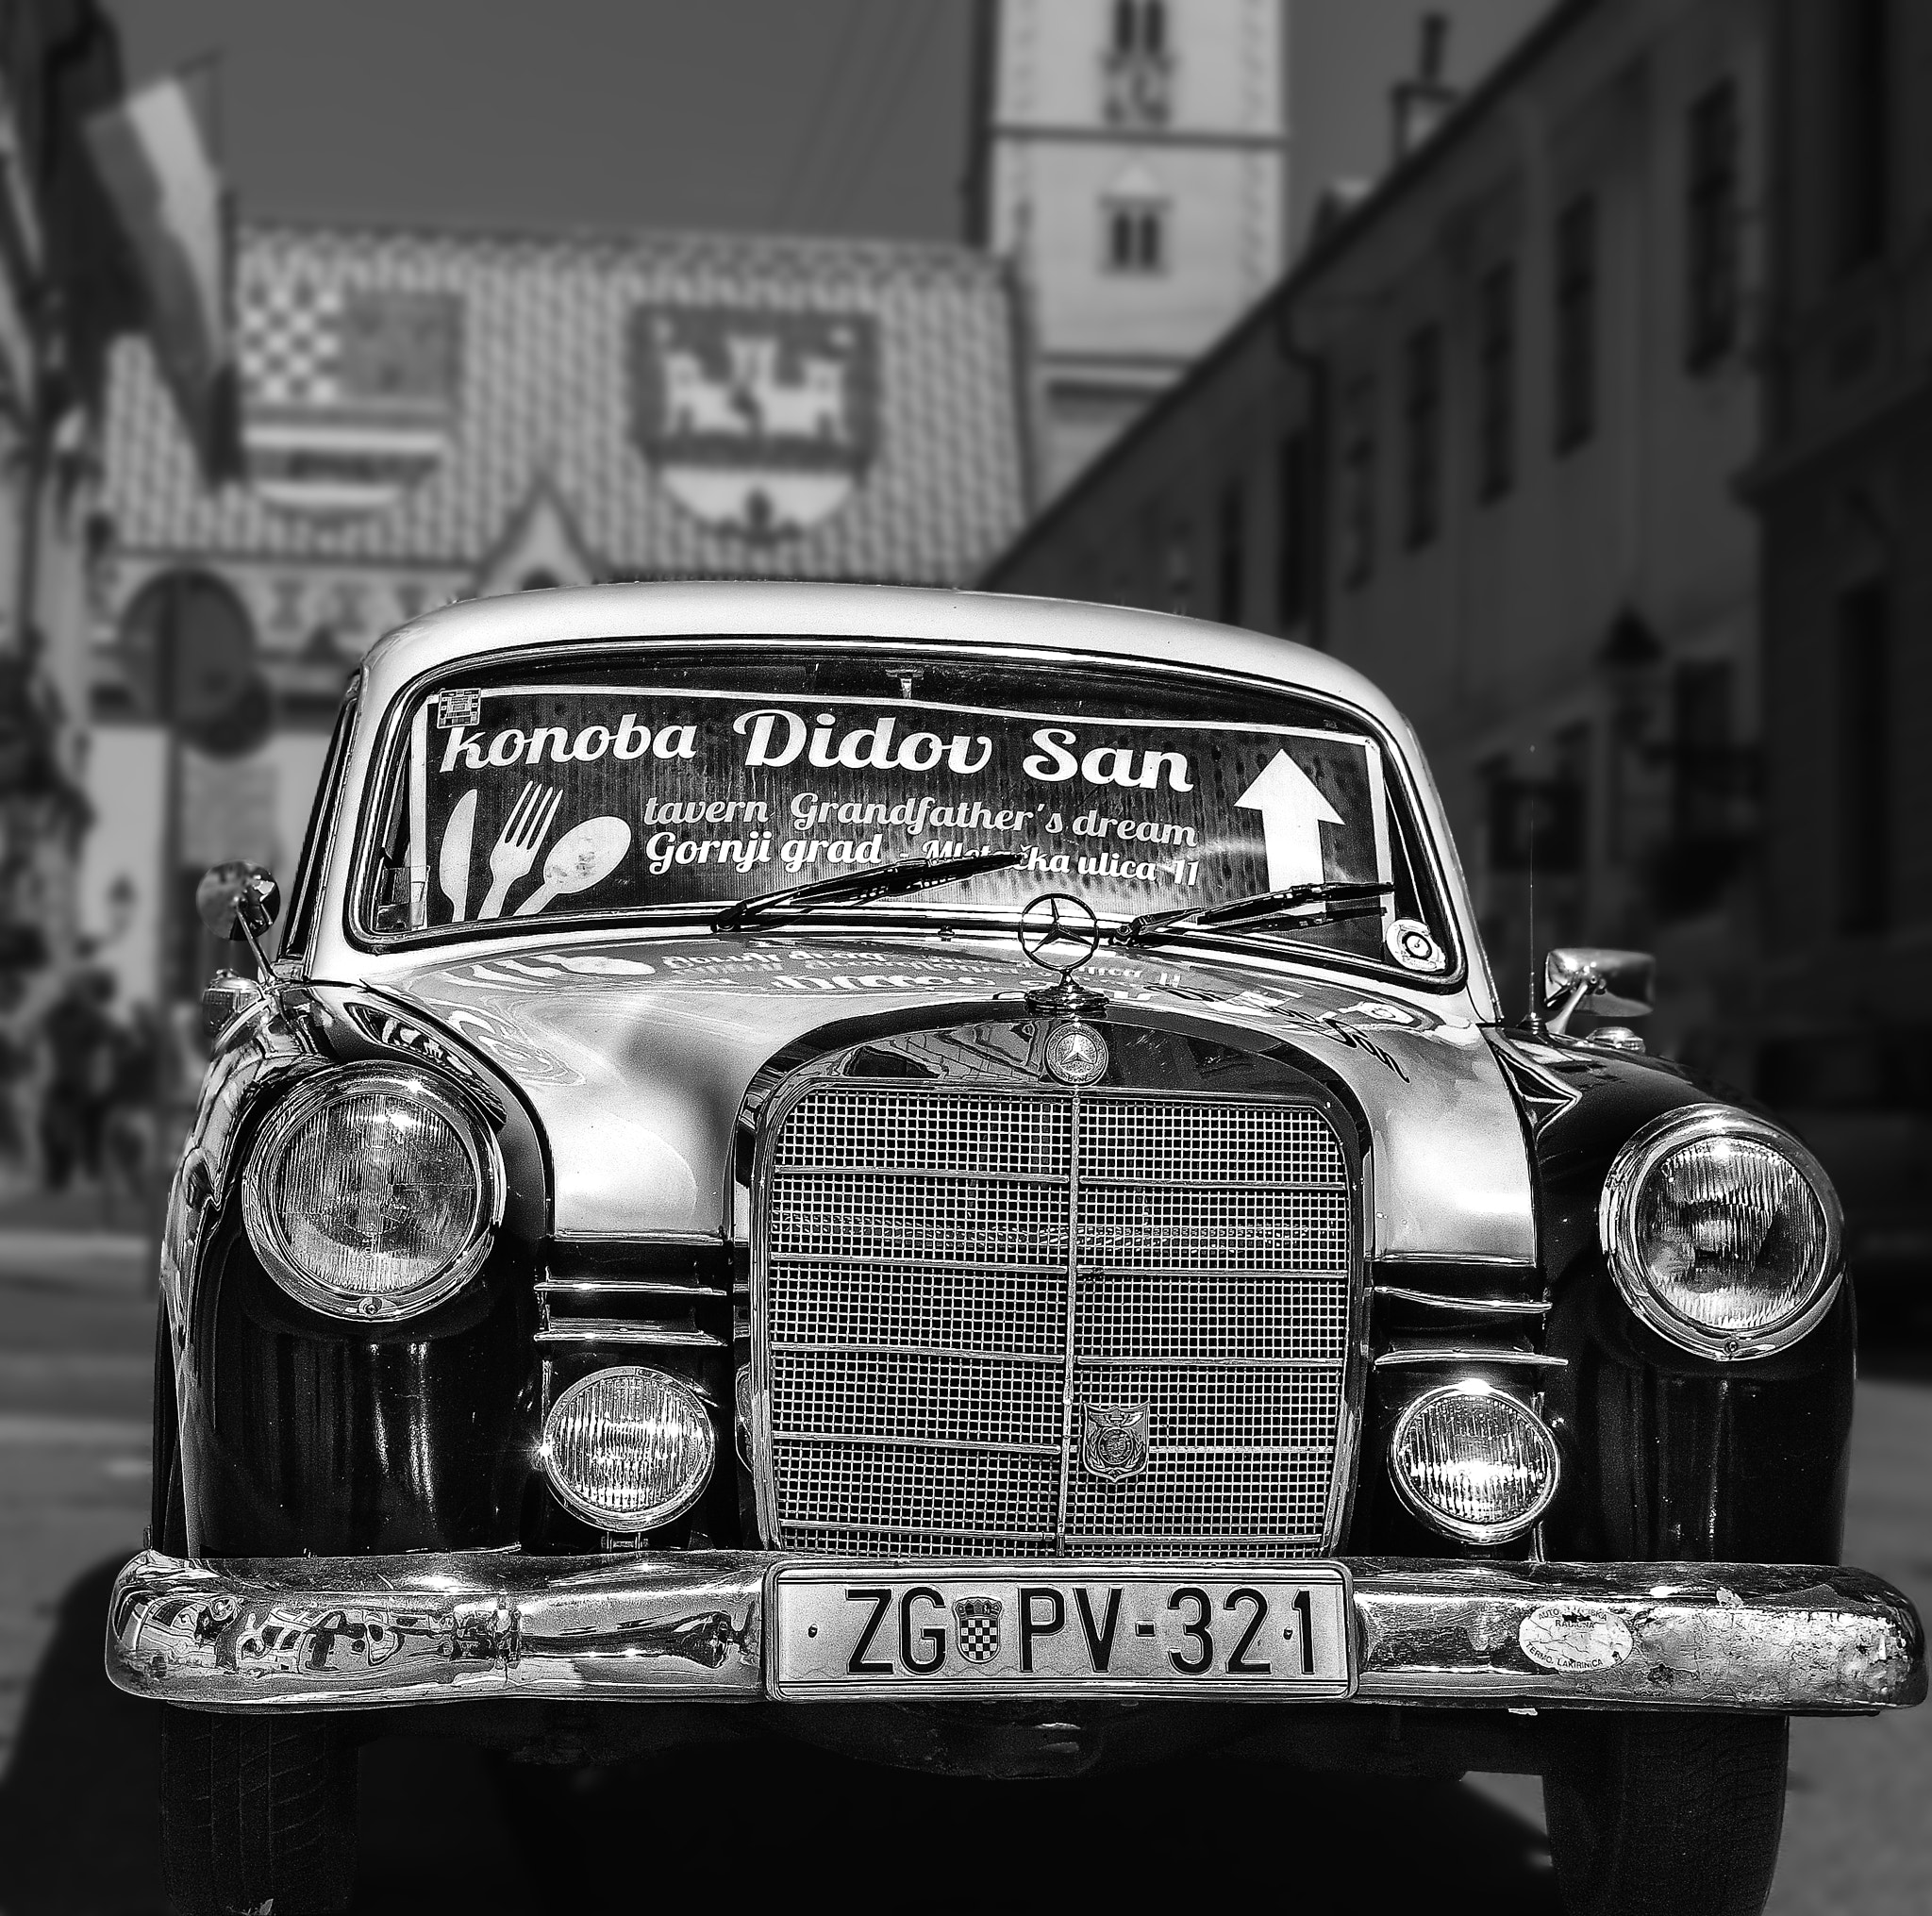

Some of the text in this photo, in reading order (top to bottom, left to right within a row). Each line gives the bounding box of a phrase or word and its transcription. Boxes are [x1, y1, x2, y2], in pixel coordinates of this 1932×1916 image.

[440, 709, 1194, 792] konoba Didov San
[643, 797, 769, 825] tavern
[1073, 809, 1197, 847] dream
[646, 831, 773, 875] Gornji
[780, 835, 882, 874] grad
[922, 839, 1070, 874] Mltčka
[1078, 852, 1157, 881] ulica
[845, 1585, 1315, 1676] ZG PV-321
[1538, 1608, 1560, 1621] AUTO
